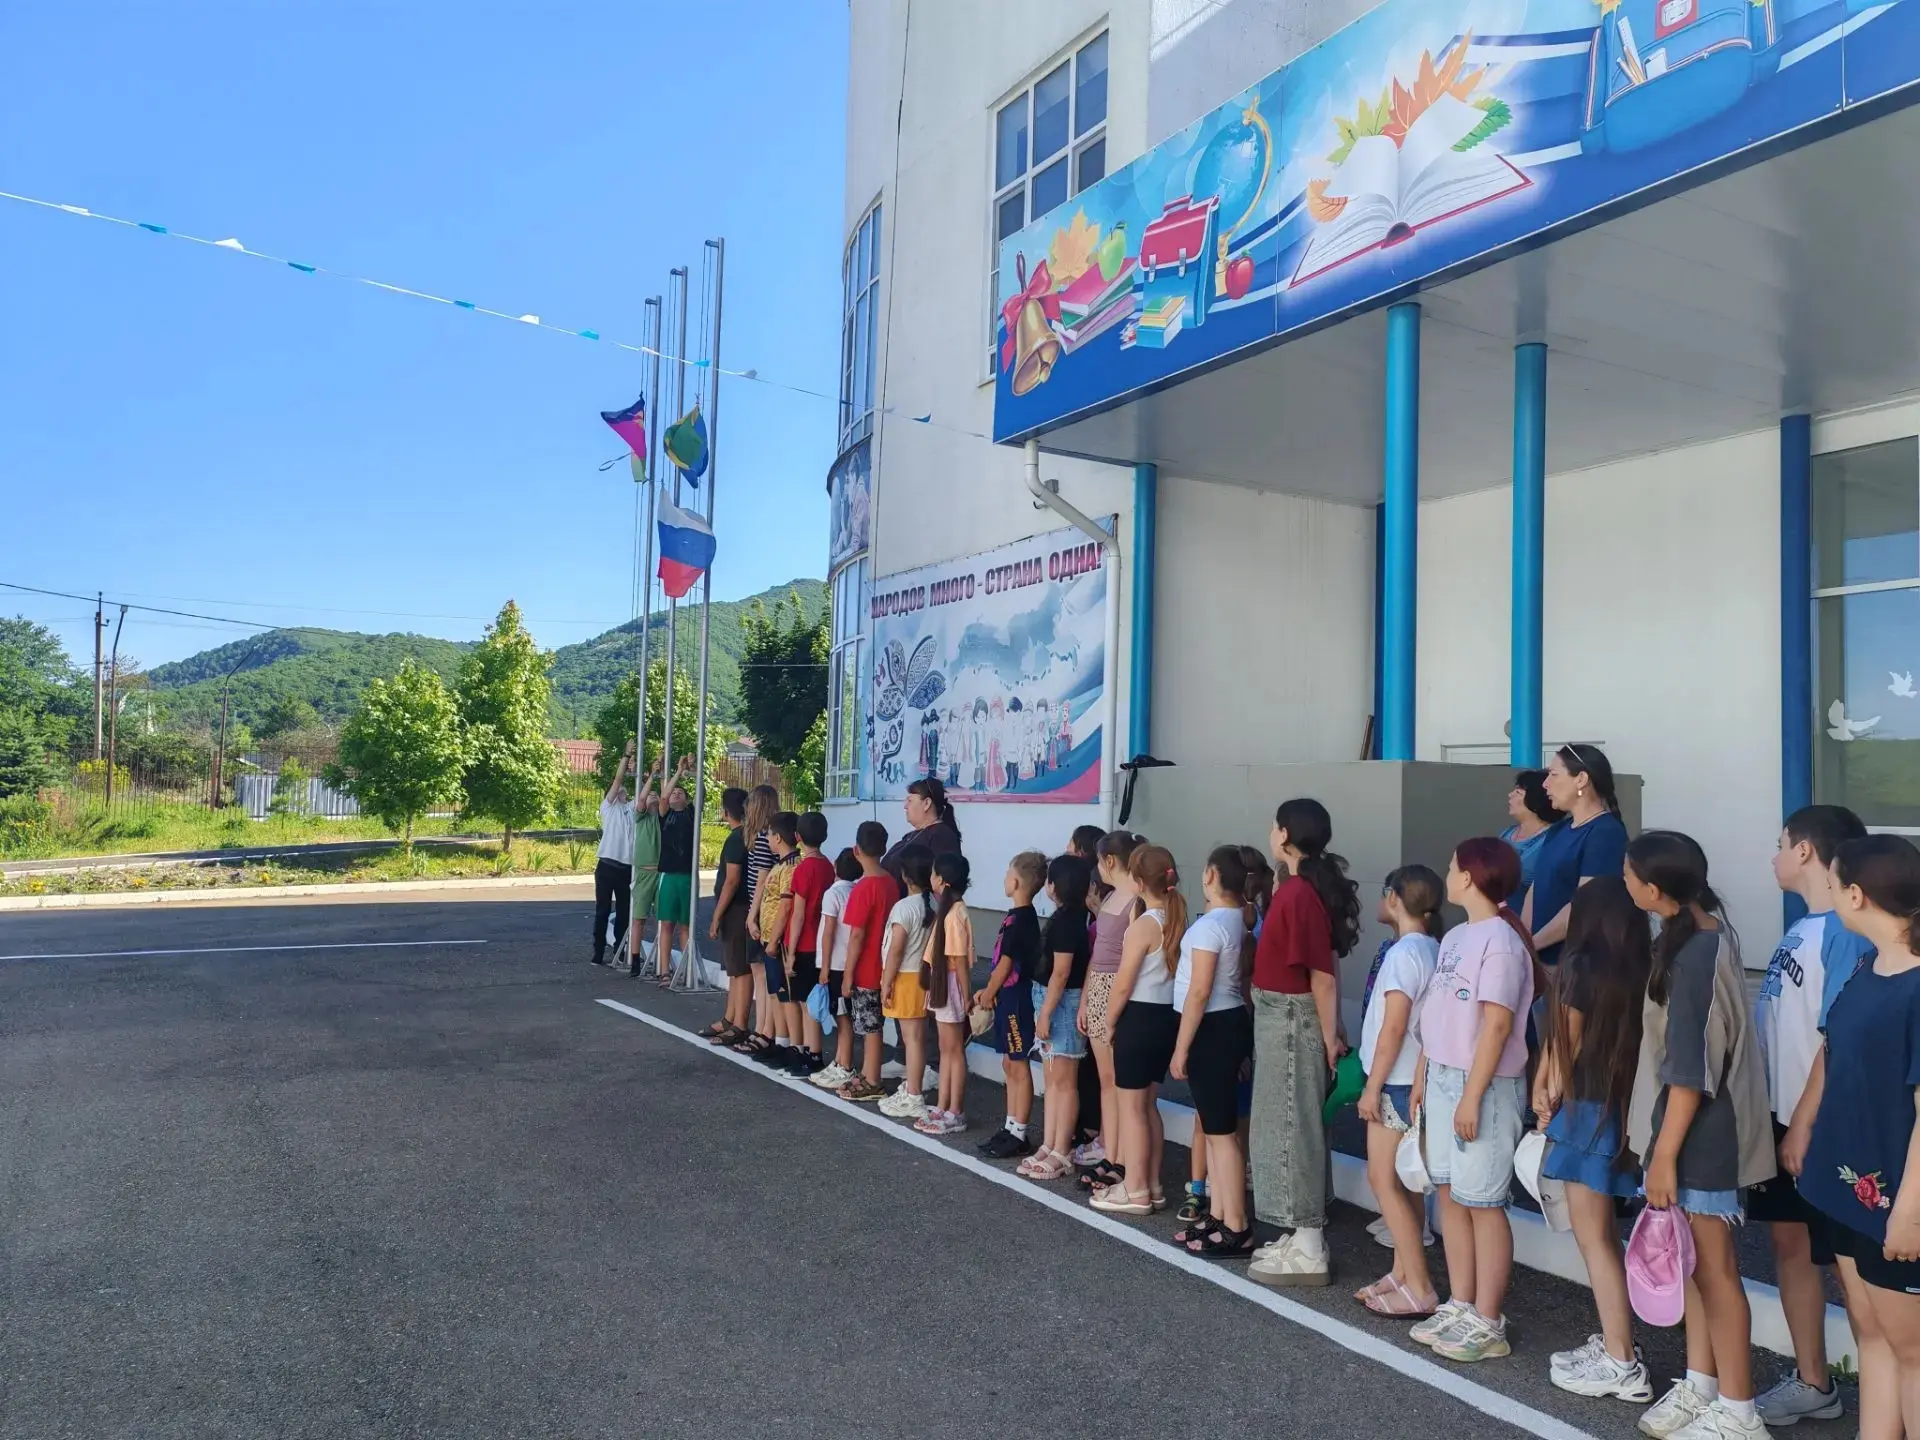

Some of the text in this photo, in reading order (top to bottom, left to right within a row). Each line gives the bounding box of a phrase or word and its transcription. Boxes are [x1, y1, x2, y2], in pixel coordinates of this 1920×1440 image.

[871, 586, 925, 619] НАРОДОВ
[929, 573, 975, 607] МНОГО
[985, 556, 1043, 595] СТРАНА
[1049, 541, 1103, 582] ОДНА!
